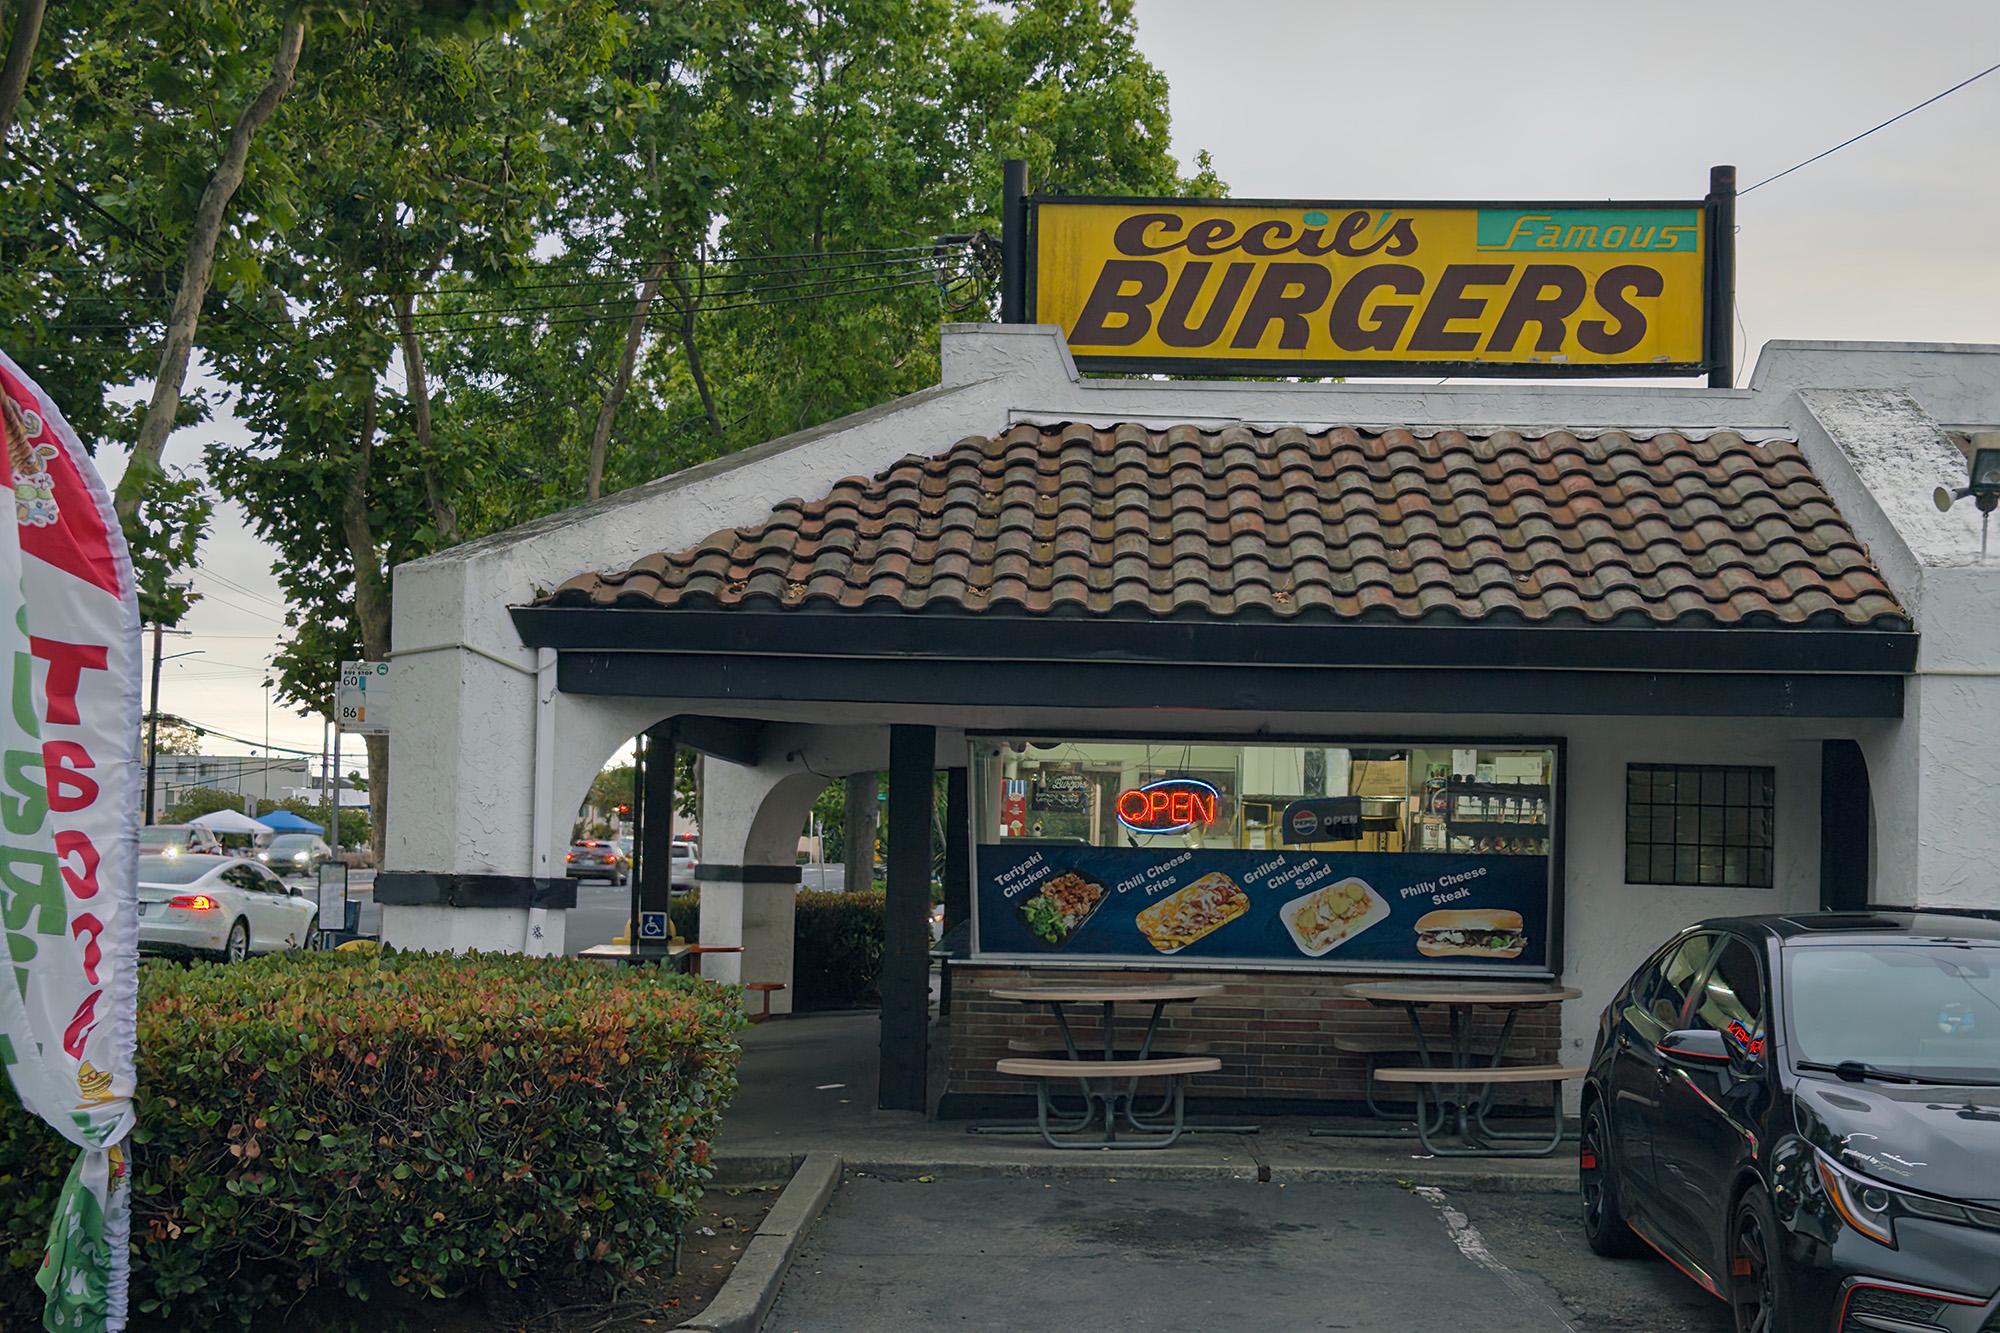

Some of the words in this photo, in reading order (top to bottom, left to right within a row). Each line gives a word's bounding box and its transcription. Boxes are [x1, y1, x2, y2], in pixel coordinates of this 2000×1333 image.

[1113, 211, 1419, 257] Cecil's
[1477, 215, 1697, 249] Famous
[1068, 259, 1664, 355] BURGERS
[343, 676, 358, 686] 60
[343, 706, 357, 718] 86
[1118, 790, 1214, 824] OPEN
[1323, 815, 1358, 826] OPEN
[994, 851, 1043, 886] Teriyaki
[1003, 864, 1051, 898] Chicken
[1116, 873, 1145, 894] Chili
[1146, 850, 1192, 879] Cheese
[1145, 875, 1177, 896] Fries
[1243, 854, 1286, 885] Grilled
[1267, 856, 1318, 890] Chicken
[1295, 864, 1332, 890] Salad
[1400, 879, 1437, 899] Philly
[1438, 865, 1487, 887] Cheese
[1432, 887, 1470, 906] Steak
